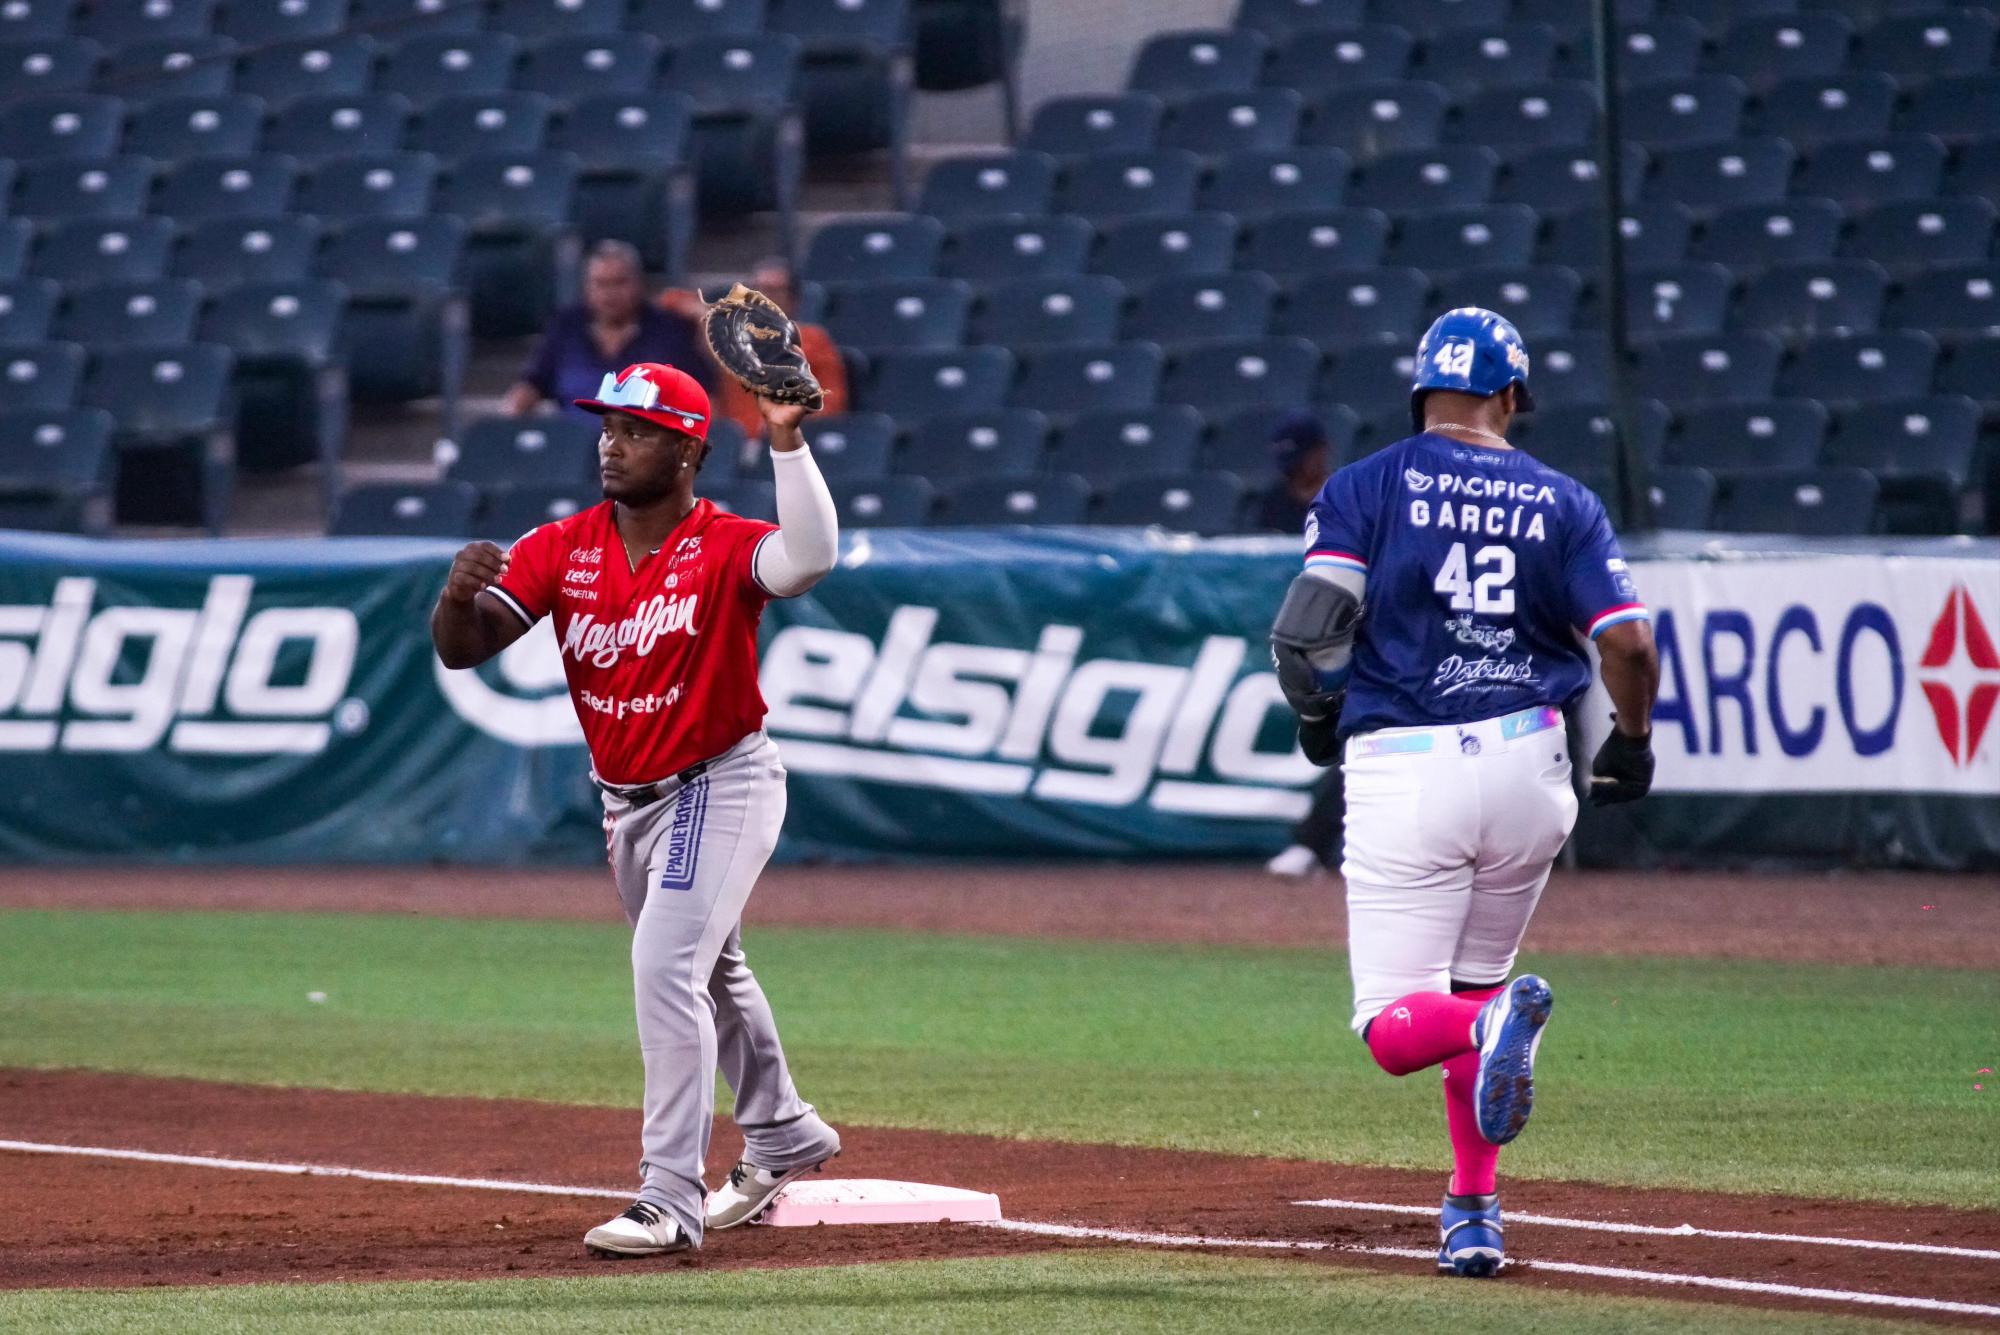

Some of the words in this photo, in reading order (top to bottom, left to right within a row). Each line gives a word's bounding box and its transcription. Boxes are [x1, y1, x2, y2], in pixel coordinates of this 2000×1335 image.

[1433, 342, 1472, 377] 42
[1438, 474, 1555, 504] PACIFICA
[1410, 499, 1546, 541] GARCÍA
[1434, 541, 1517, 615] 42
[561, 593, 700, 669] Mazatlán
[617, 682, 686, 720] petro
[1650, 603, 1904, 758] ARCO
